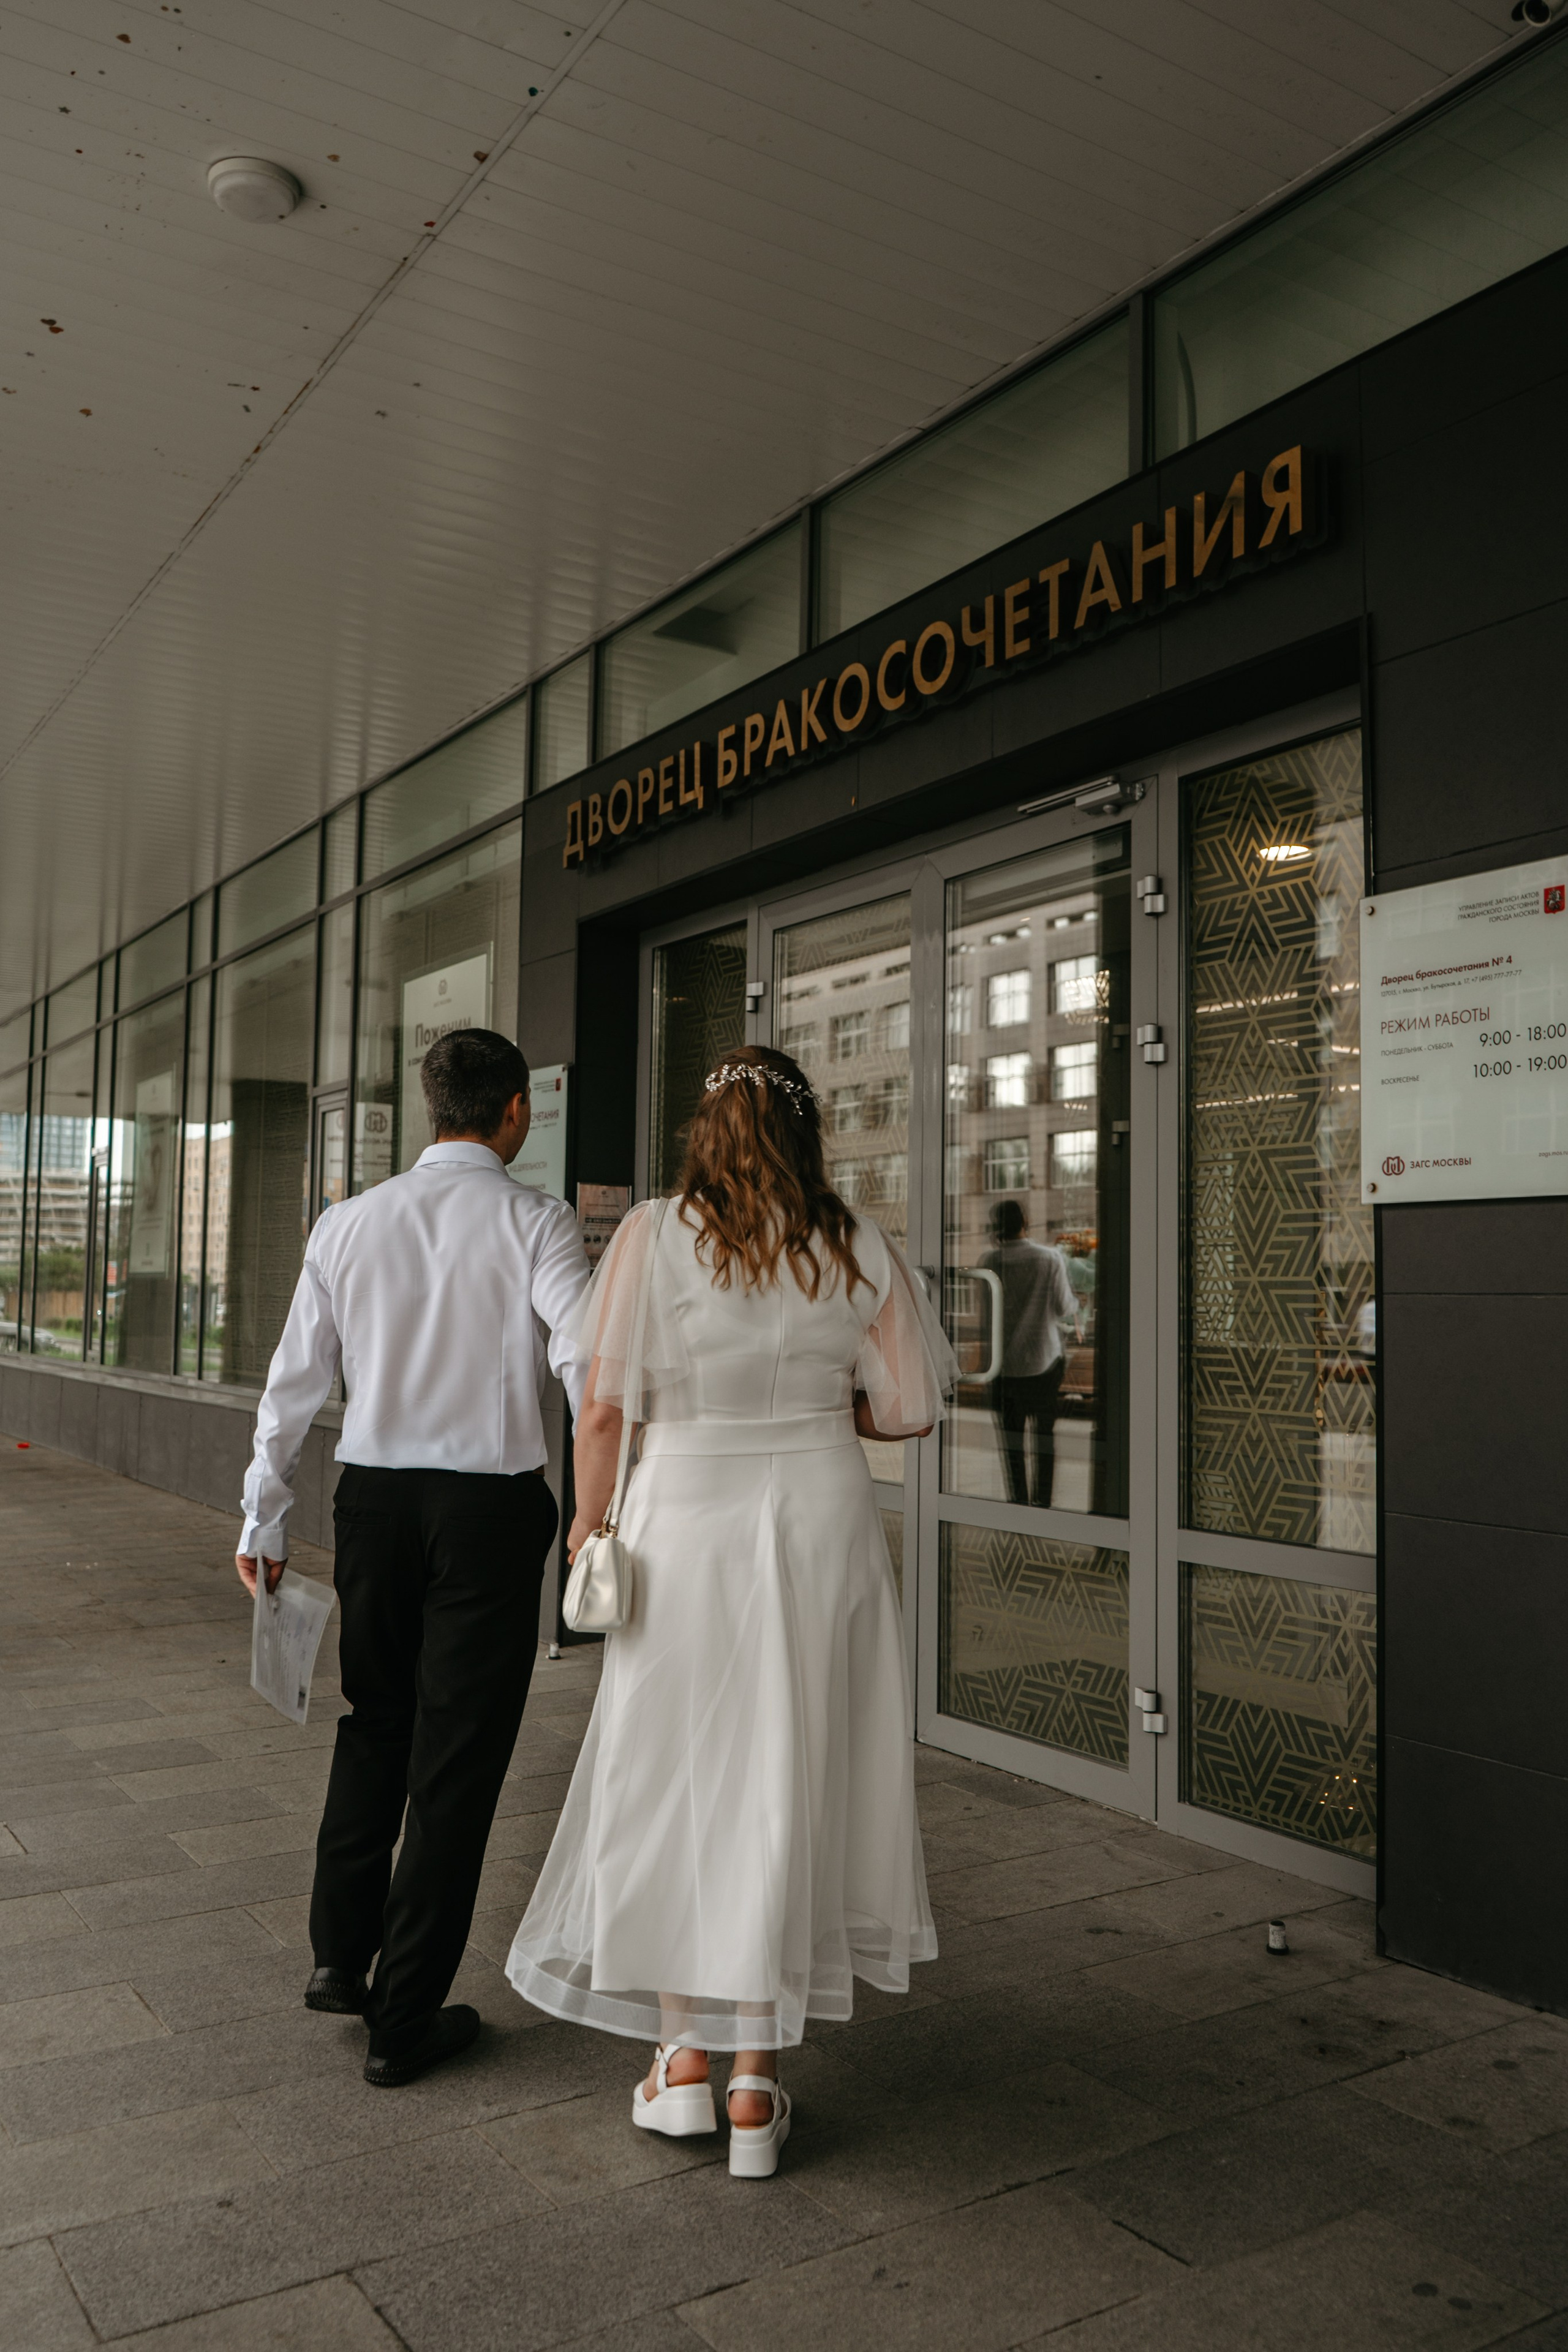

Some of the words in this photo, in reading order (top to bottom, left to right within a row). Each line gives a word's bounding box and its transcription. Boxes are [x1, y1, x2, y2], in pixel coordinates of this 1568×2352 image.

[563, 741, 704, 869] ДВОРЕЦ
[717, 444, 1302, 788] БРАКОСОЧЕТАНИЯ
[1458, 900, 1494, 911] УПРАВЛЕНИЕ
[1495, 895, 1520, 905] ЗАПИСИ
[1458, 907, 1502, 920] ГРАЖДАНСКОГО
[1503, 899, 1539, 911] СОСТОЯНИЯ
[1489, 914, 1512, 923] ГОРОДА
[1513, 908, 1539, 918] МОСКВЫ
[1381, 975, 1414, 986] Дворец
[1415, 960, 1490, 980] бракосочетания
[1506, 955, 1513, 964] 4
[1479, 974, 1493, 982] (495)
[1493, 969, 1522, 980] 777-77-77
[1381, 1016, 1430, 1035] РЕЖИМ
[1435, 1006, 1490, 1027] РАБОТЫ
[1479, 1030, 1511, 1047] 9:00
[1528, 1023, 1567, 1041] 18:00
[1381, 1046, 1423, 1057] ПОНЕДЕЛЬНИК
[1427, 1042, 1453, 1051] СУББОТА
[1473, 1060, 1512, 1077] 10:00
[1528, 1054, 1567, 1072] 19:00
[1381, 1075, 1420, 1085] ВОСКРЕСЕНЬЕ
[531, 1109, 559, 1122] ОЧЕТАНИЯ
[1432, 1157, 1471, 1167] МОСКВЫ
